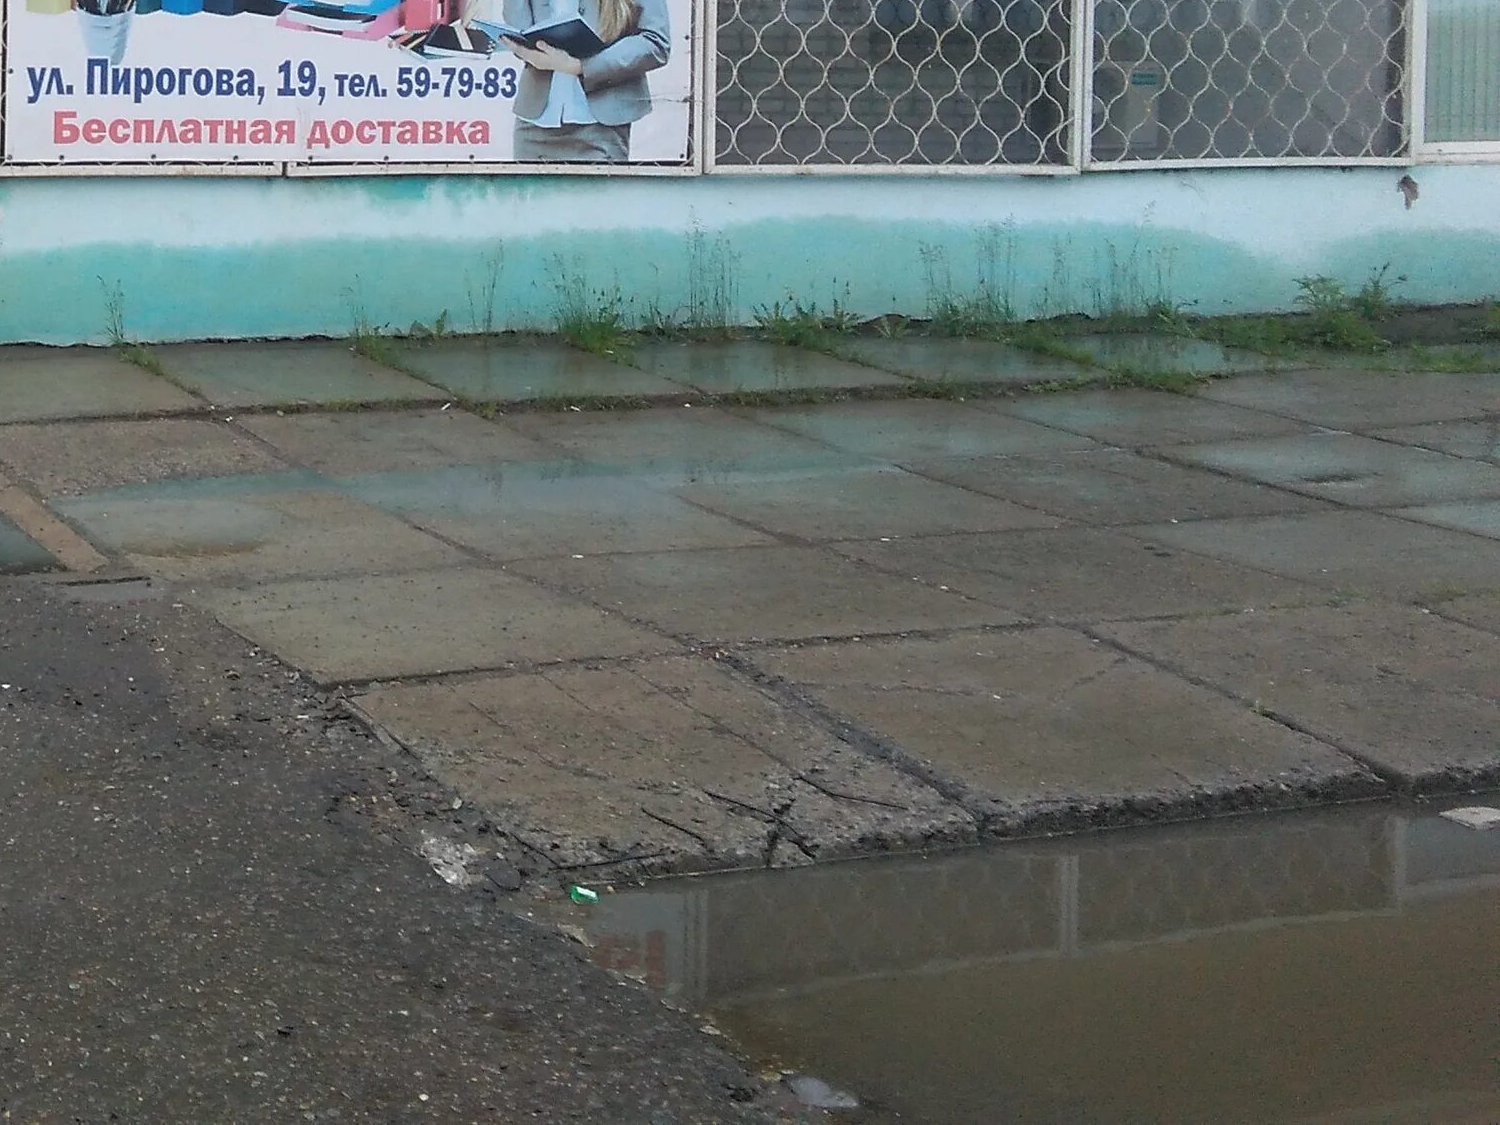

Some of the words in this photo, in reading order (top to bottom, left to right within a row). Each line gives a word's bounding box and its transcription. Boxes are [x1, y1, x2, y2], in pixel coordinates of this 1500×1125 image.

[27, 65, 74, 104] ул.
[86, 60, 267, 101] Пирогова,
[277, 60, 327, 106] 19,
[334, 75, 388, 98] тел.
[396, 66, 518, 100] 59-79-83
[53, 111, 296, 146] Бесплатная
[307, 120, 491, 149] доставка
